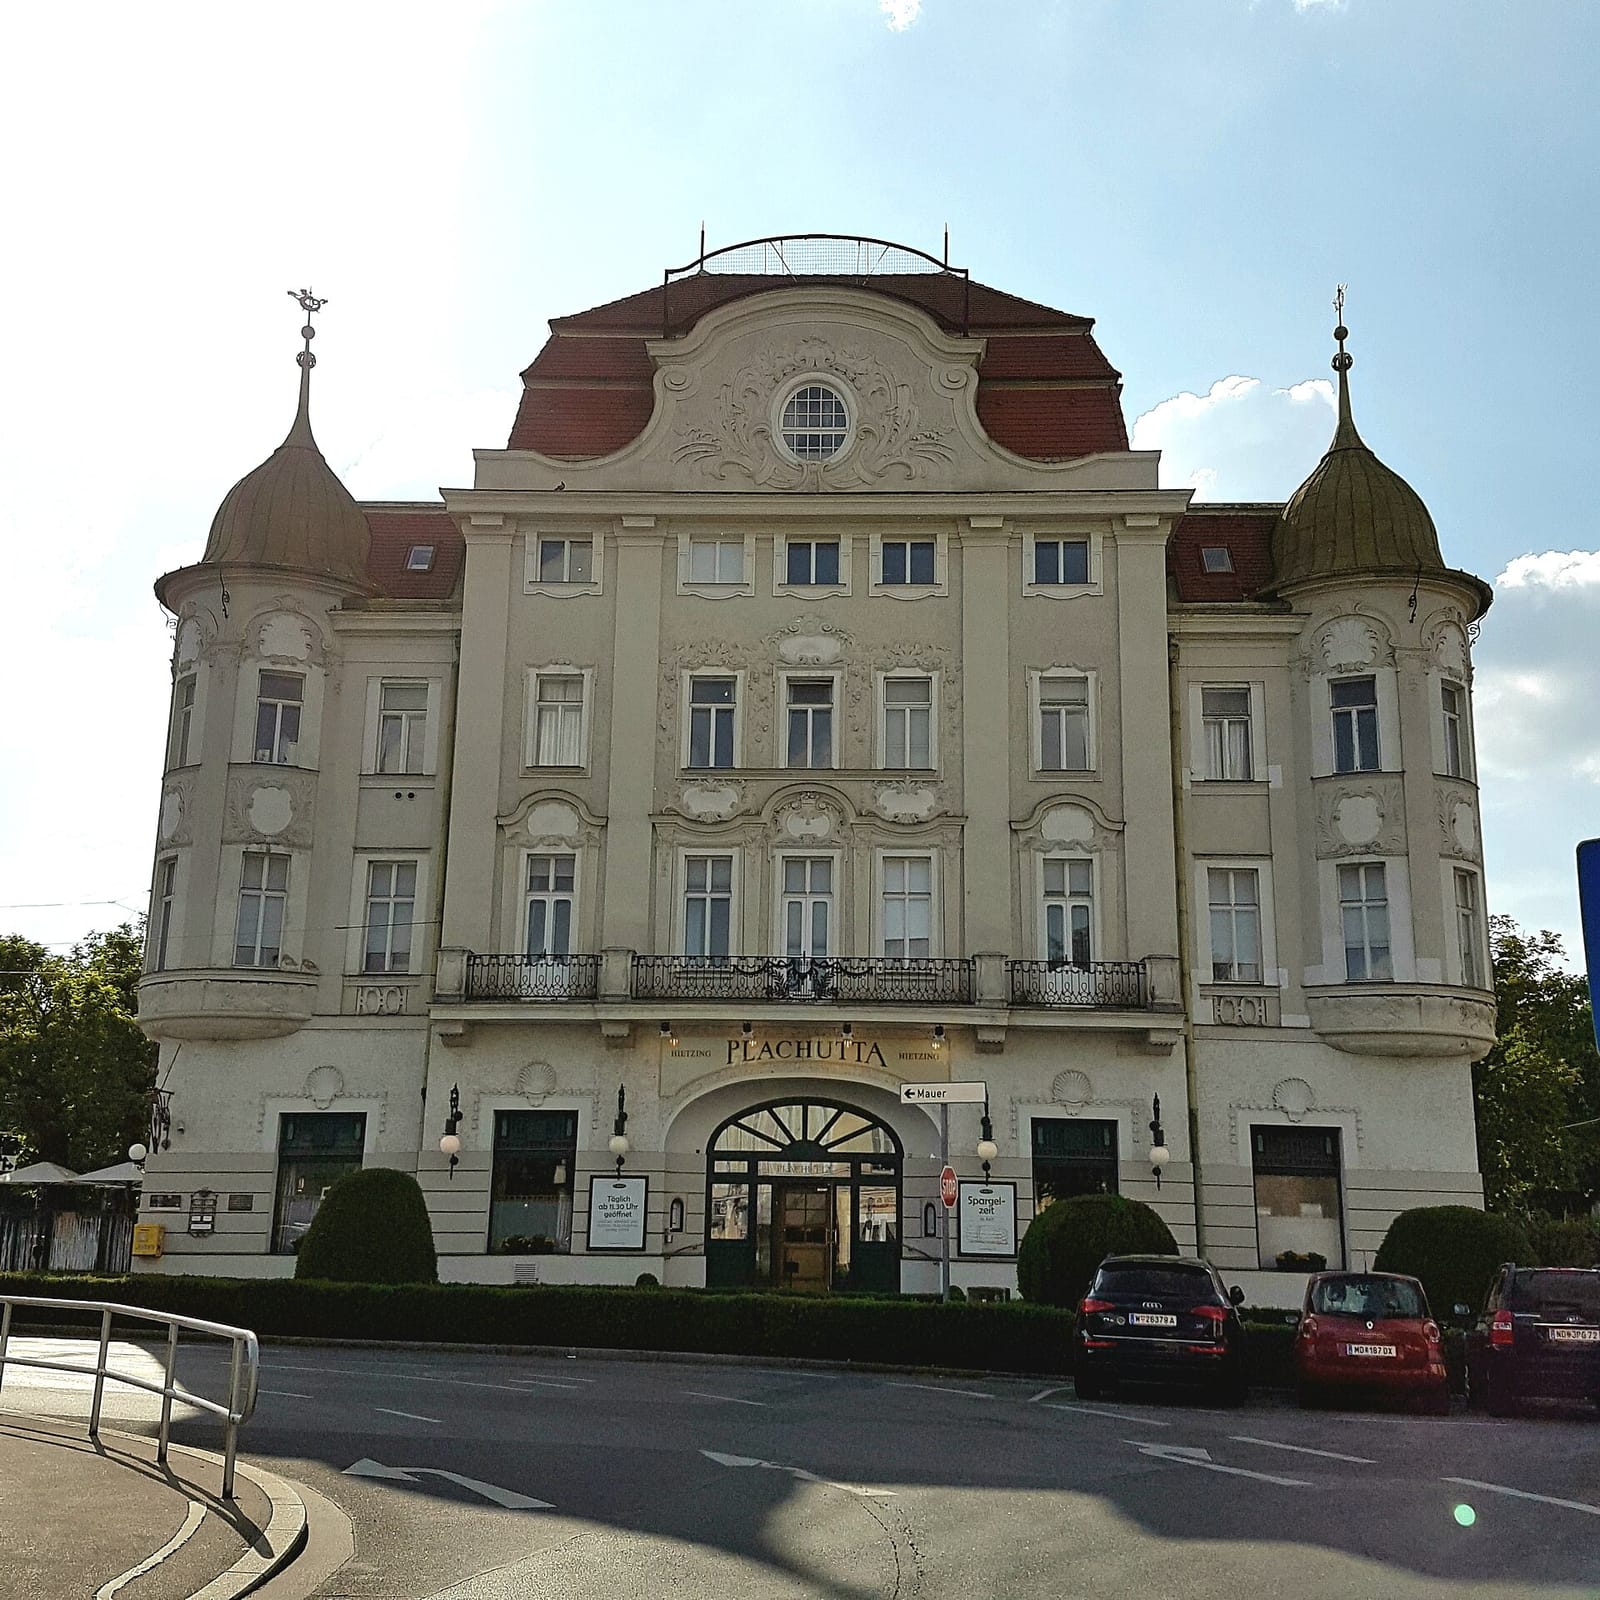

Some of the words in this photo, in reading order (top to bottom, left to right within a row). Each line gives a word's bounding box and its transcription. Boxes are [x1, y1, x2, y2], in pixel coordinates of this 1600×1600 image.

[671, 1049, 712, 1058] HIETZING
[726, 1039, 888, 1068] PLACHUTTA
[898, 1052, 940, 1061] HIETZING
[917, 1088, 947, 1099] Mauer
[942, 1178, 956, 1195] STOP
[607, 1195, 631, 1203] Täglich
[967, 1195, 1006, 1207] Spargel-
[626, 1202, 639, 1210] Uhr
[978, 1207, 995, 1215] zeit
